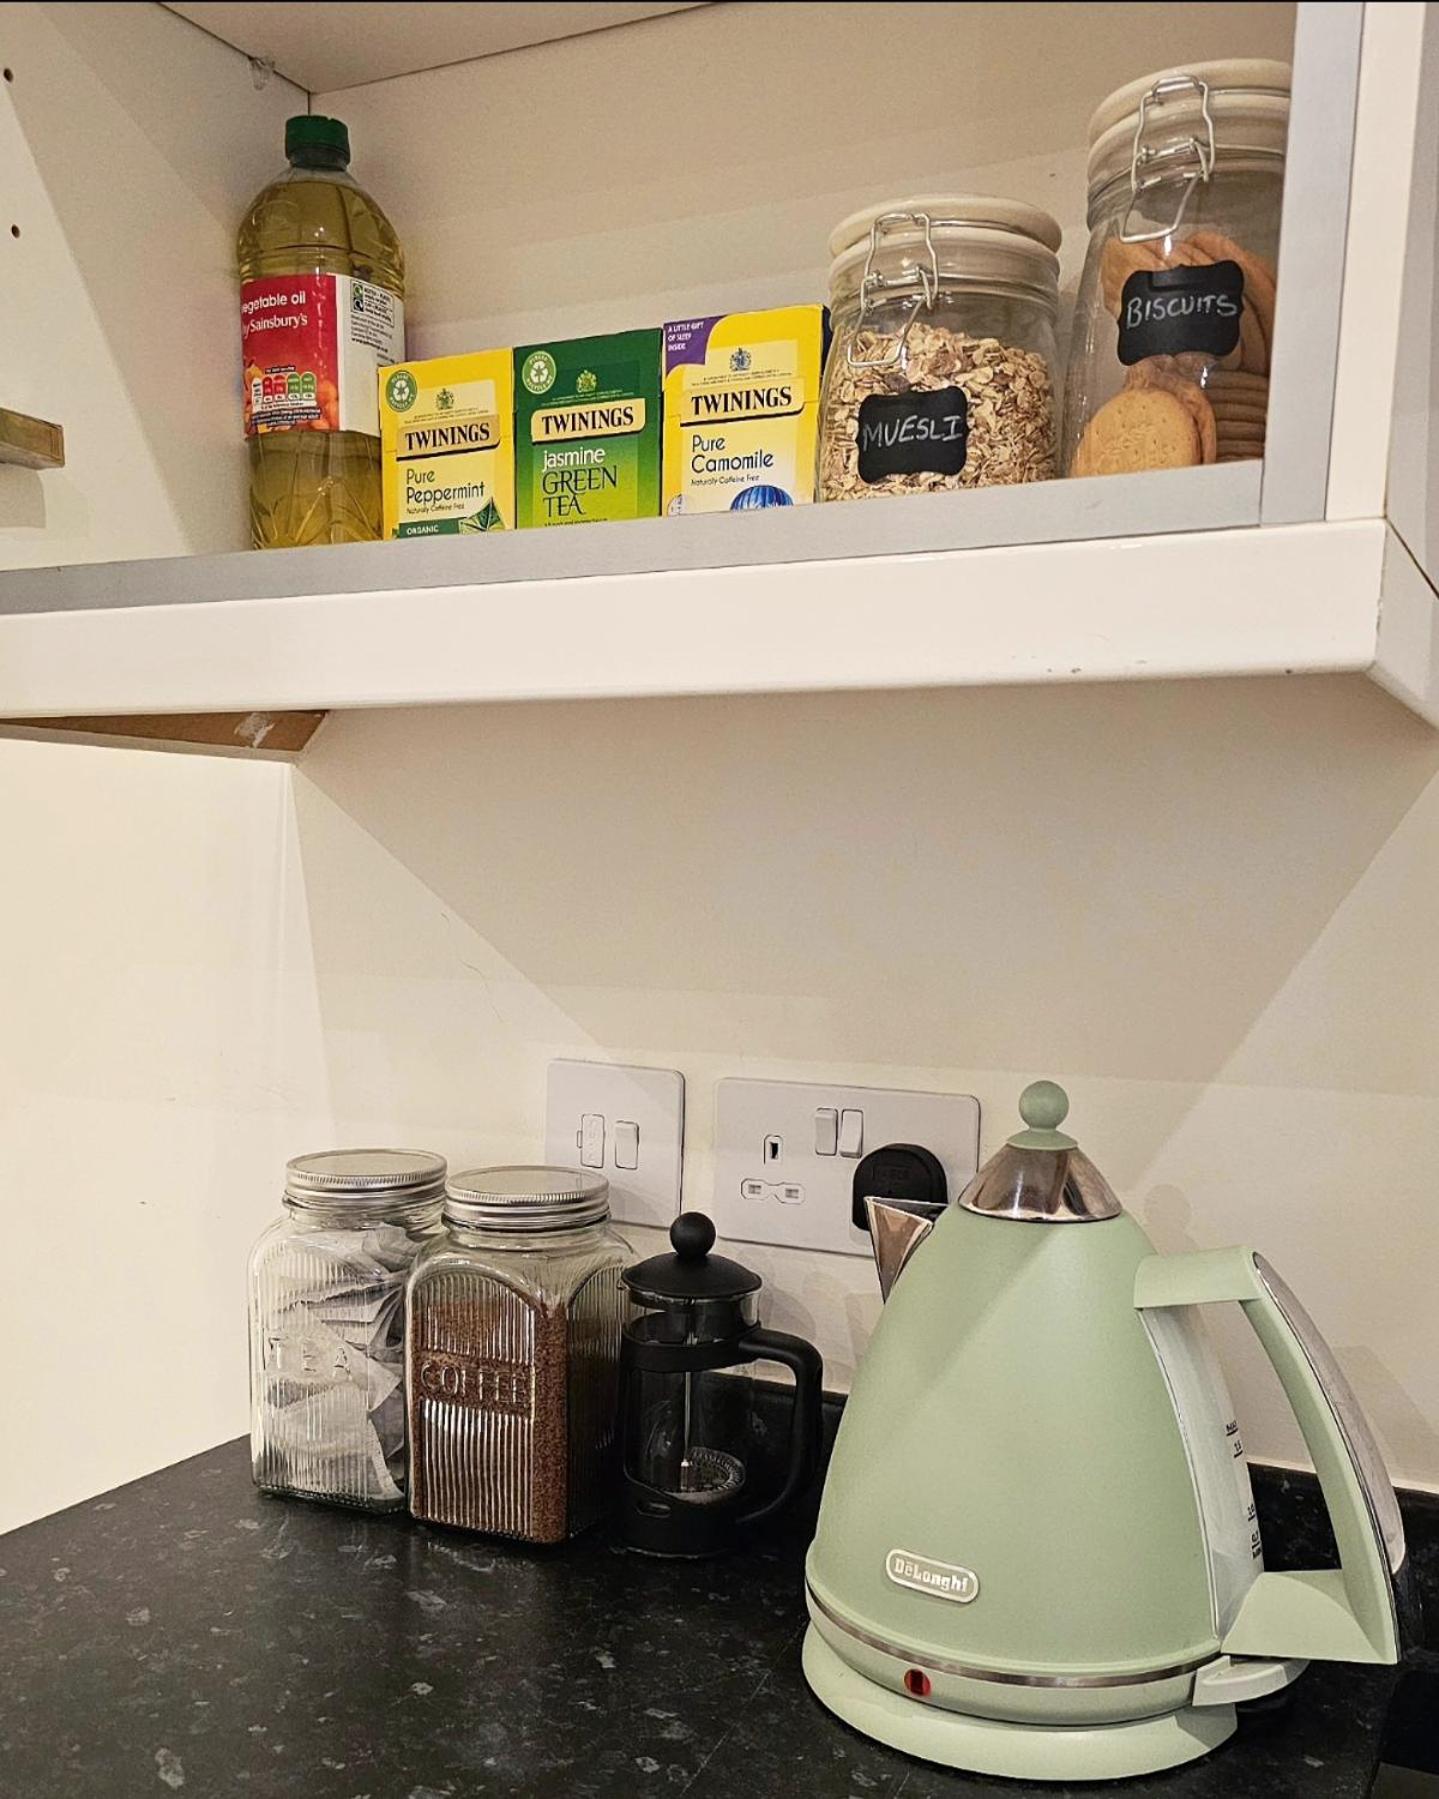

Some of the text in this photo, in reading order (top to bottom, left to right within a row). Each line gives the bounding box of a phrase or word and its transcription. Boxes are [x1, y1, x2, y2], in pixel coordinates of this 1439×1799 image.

[241, 290, 306, 314] egetable oil
[1126, 294, 1239, 330] BISCUITS
[249, 313, 308, 332] Sainsbury's
[691, 386, 792, 416] TWININGS
[541, 406, 634, 435] TWININGS
[862, 414, 964, 452] MUESLI
[405, 422, 490, 450] TWININGS
[692, 434, 726, 452] Pure
[542, 446, 606, 472] jasmine
[691, 449, 774, 474] Camomile
[406, 468, 435, 485] Pure
[542, 465, 618, 495] GREEN
[691, 476, 718, 487] Naturally
[718, 475, 745, 485] Caffeine
[406, 482, 485, 505] Peppermint
[543, 493, 587, 518] TEA
[406, 524, 439, 536] ORGANIC
[421, 1360, 532, 1406] COFFEE
